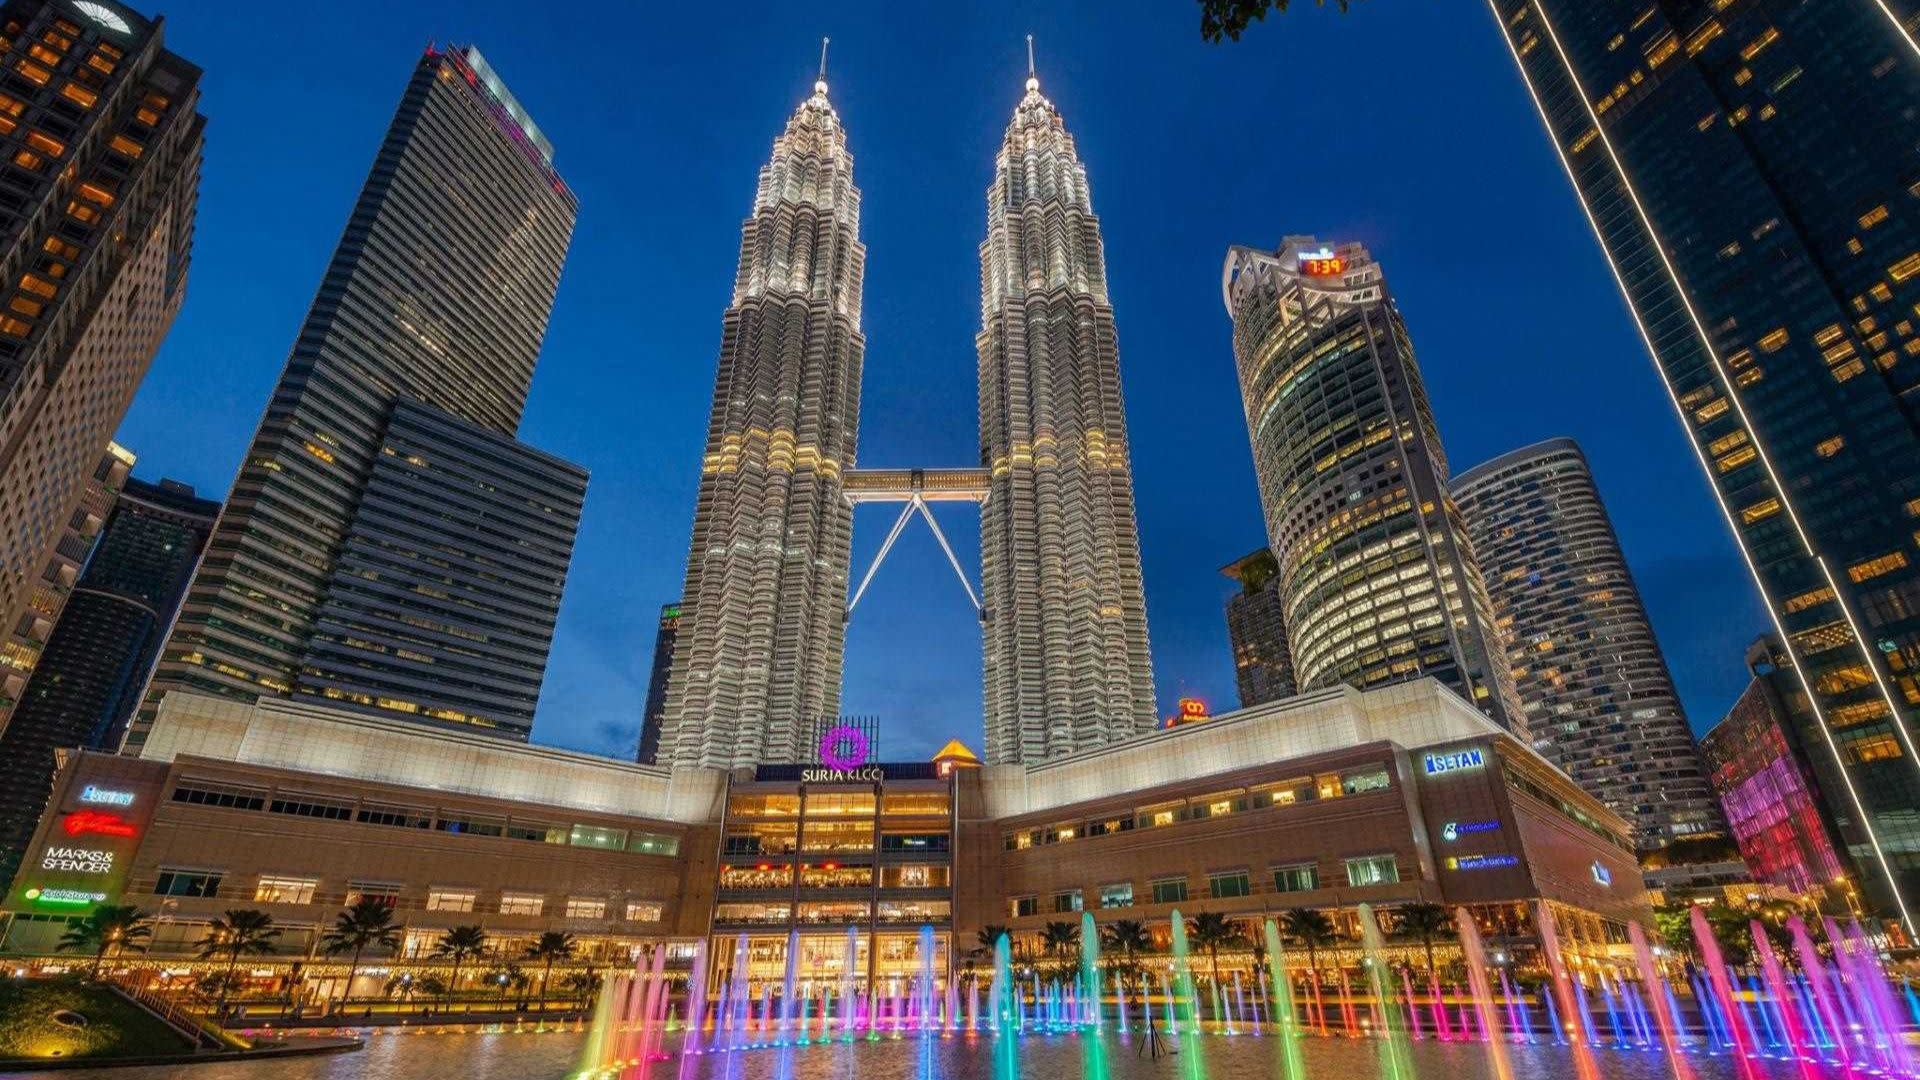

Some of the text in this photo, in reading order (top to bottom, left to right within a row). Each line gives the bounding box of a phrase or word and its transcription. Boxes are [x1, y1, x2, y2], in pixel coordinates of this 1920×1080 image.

[803, 768, 880, 781] SURIA KLCC
[46, 847, 114, 863] MARKS &
[42, 857, 111, 873] SPENCER
